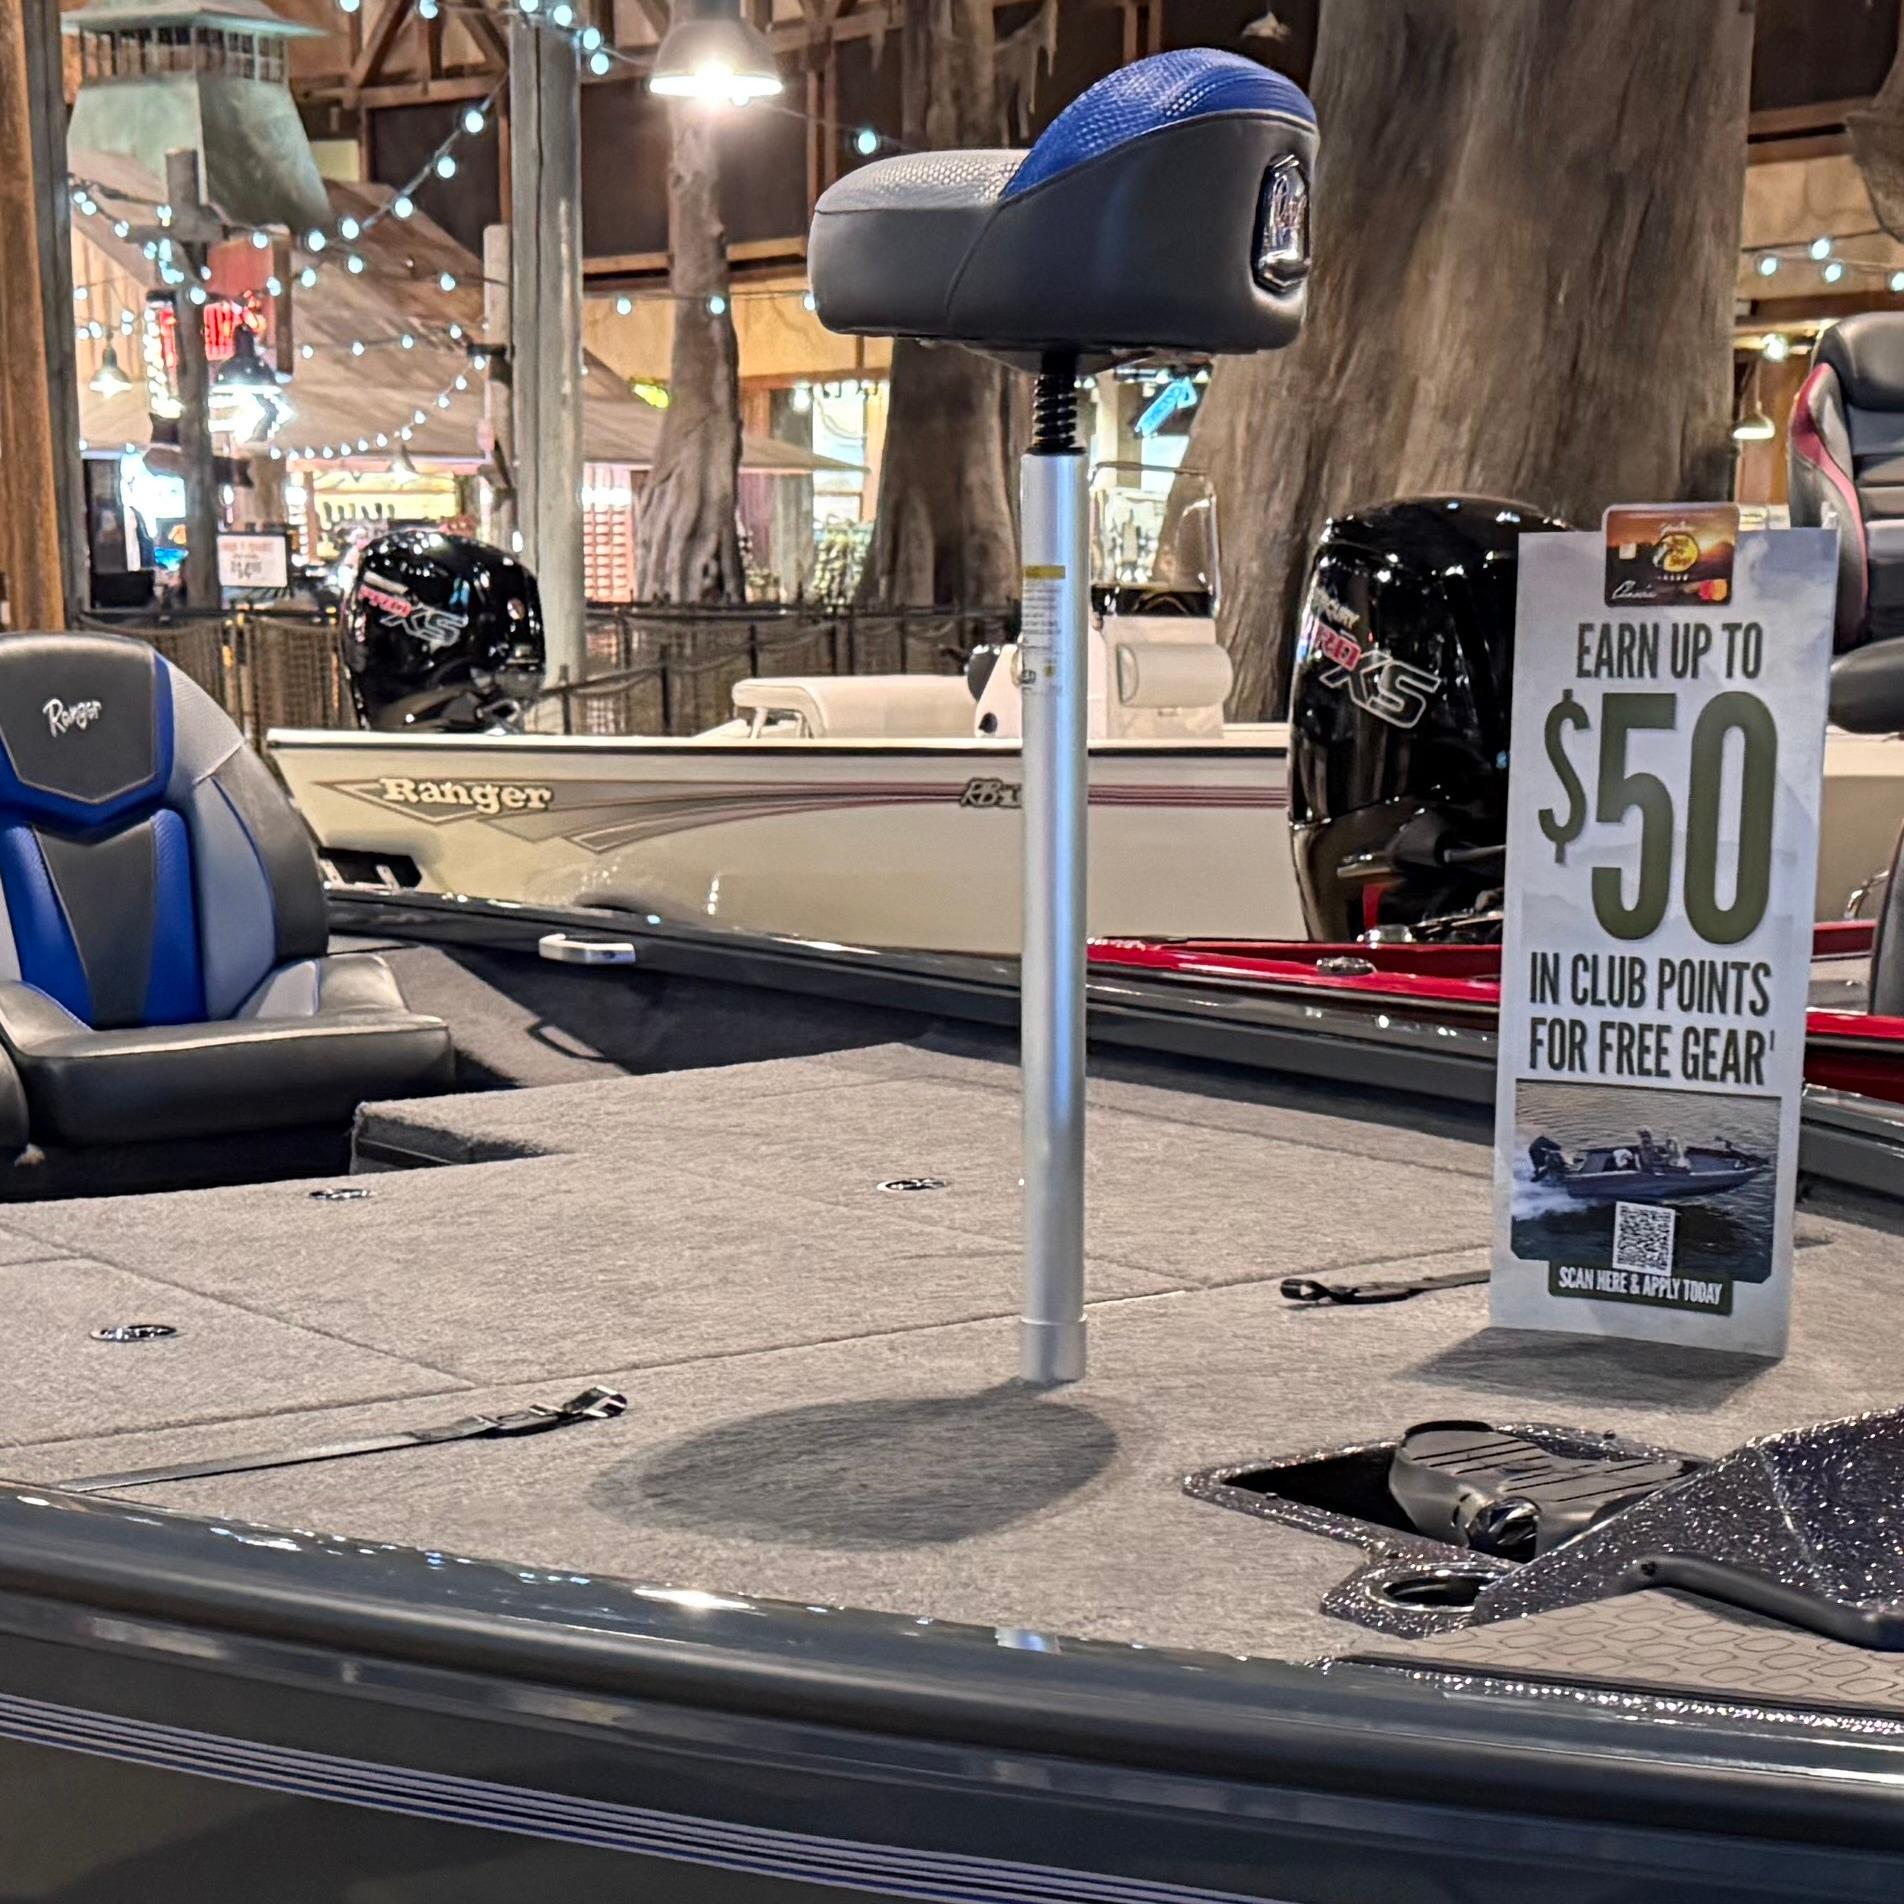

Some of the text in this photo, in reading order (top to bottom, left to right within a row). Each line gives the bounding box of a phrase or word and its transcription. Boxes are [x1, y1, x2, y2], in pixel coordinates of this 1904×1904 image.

[1576, 622, 1764, 679] EARN UP TO
[1319, 649, 1442, 729] XS
[380, 778, 553, 815] Ranger
[1538, 688, 1778, 945] $50
[1530, 952, 1772, 1016] IN CLUB POINTS
[1530, 1017, 1588, 1073] FOR
[1599, 1021, 1672, 1078] FREE
[1558, 1266, 1723, 1305] SCAN HERE & APPLY TODAY
